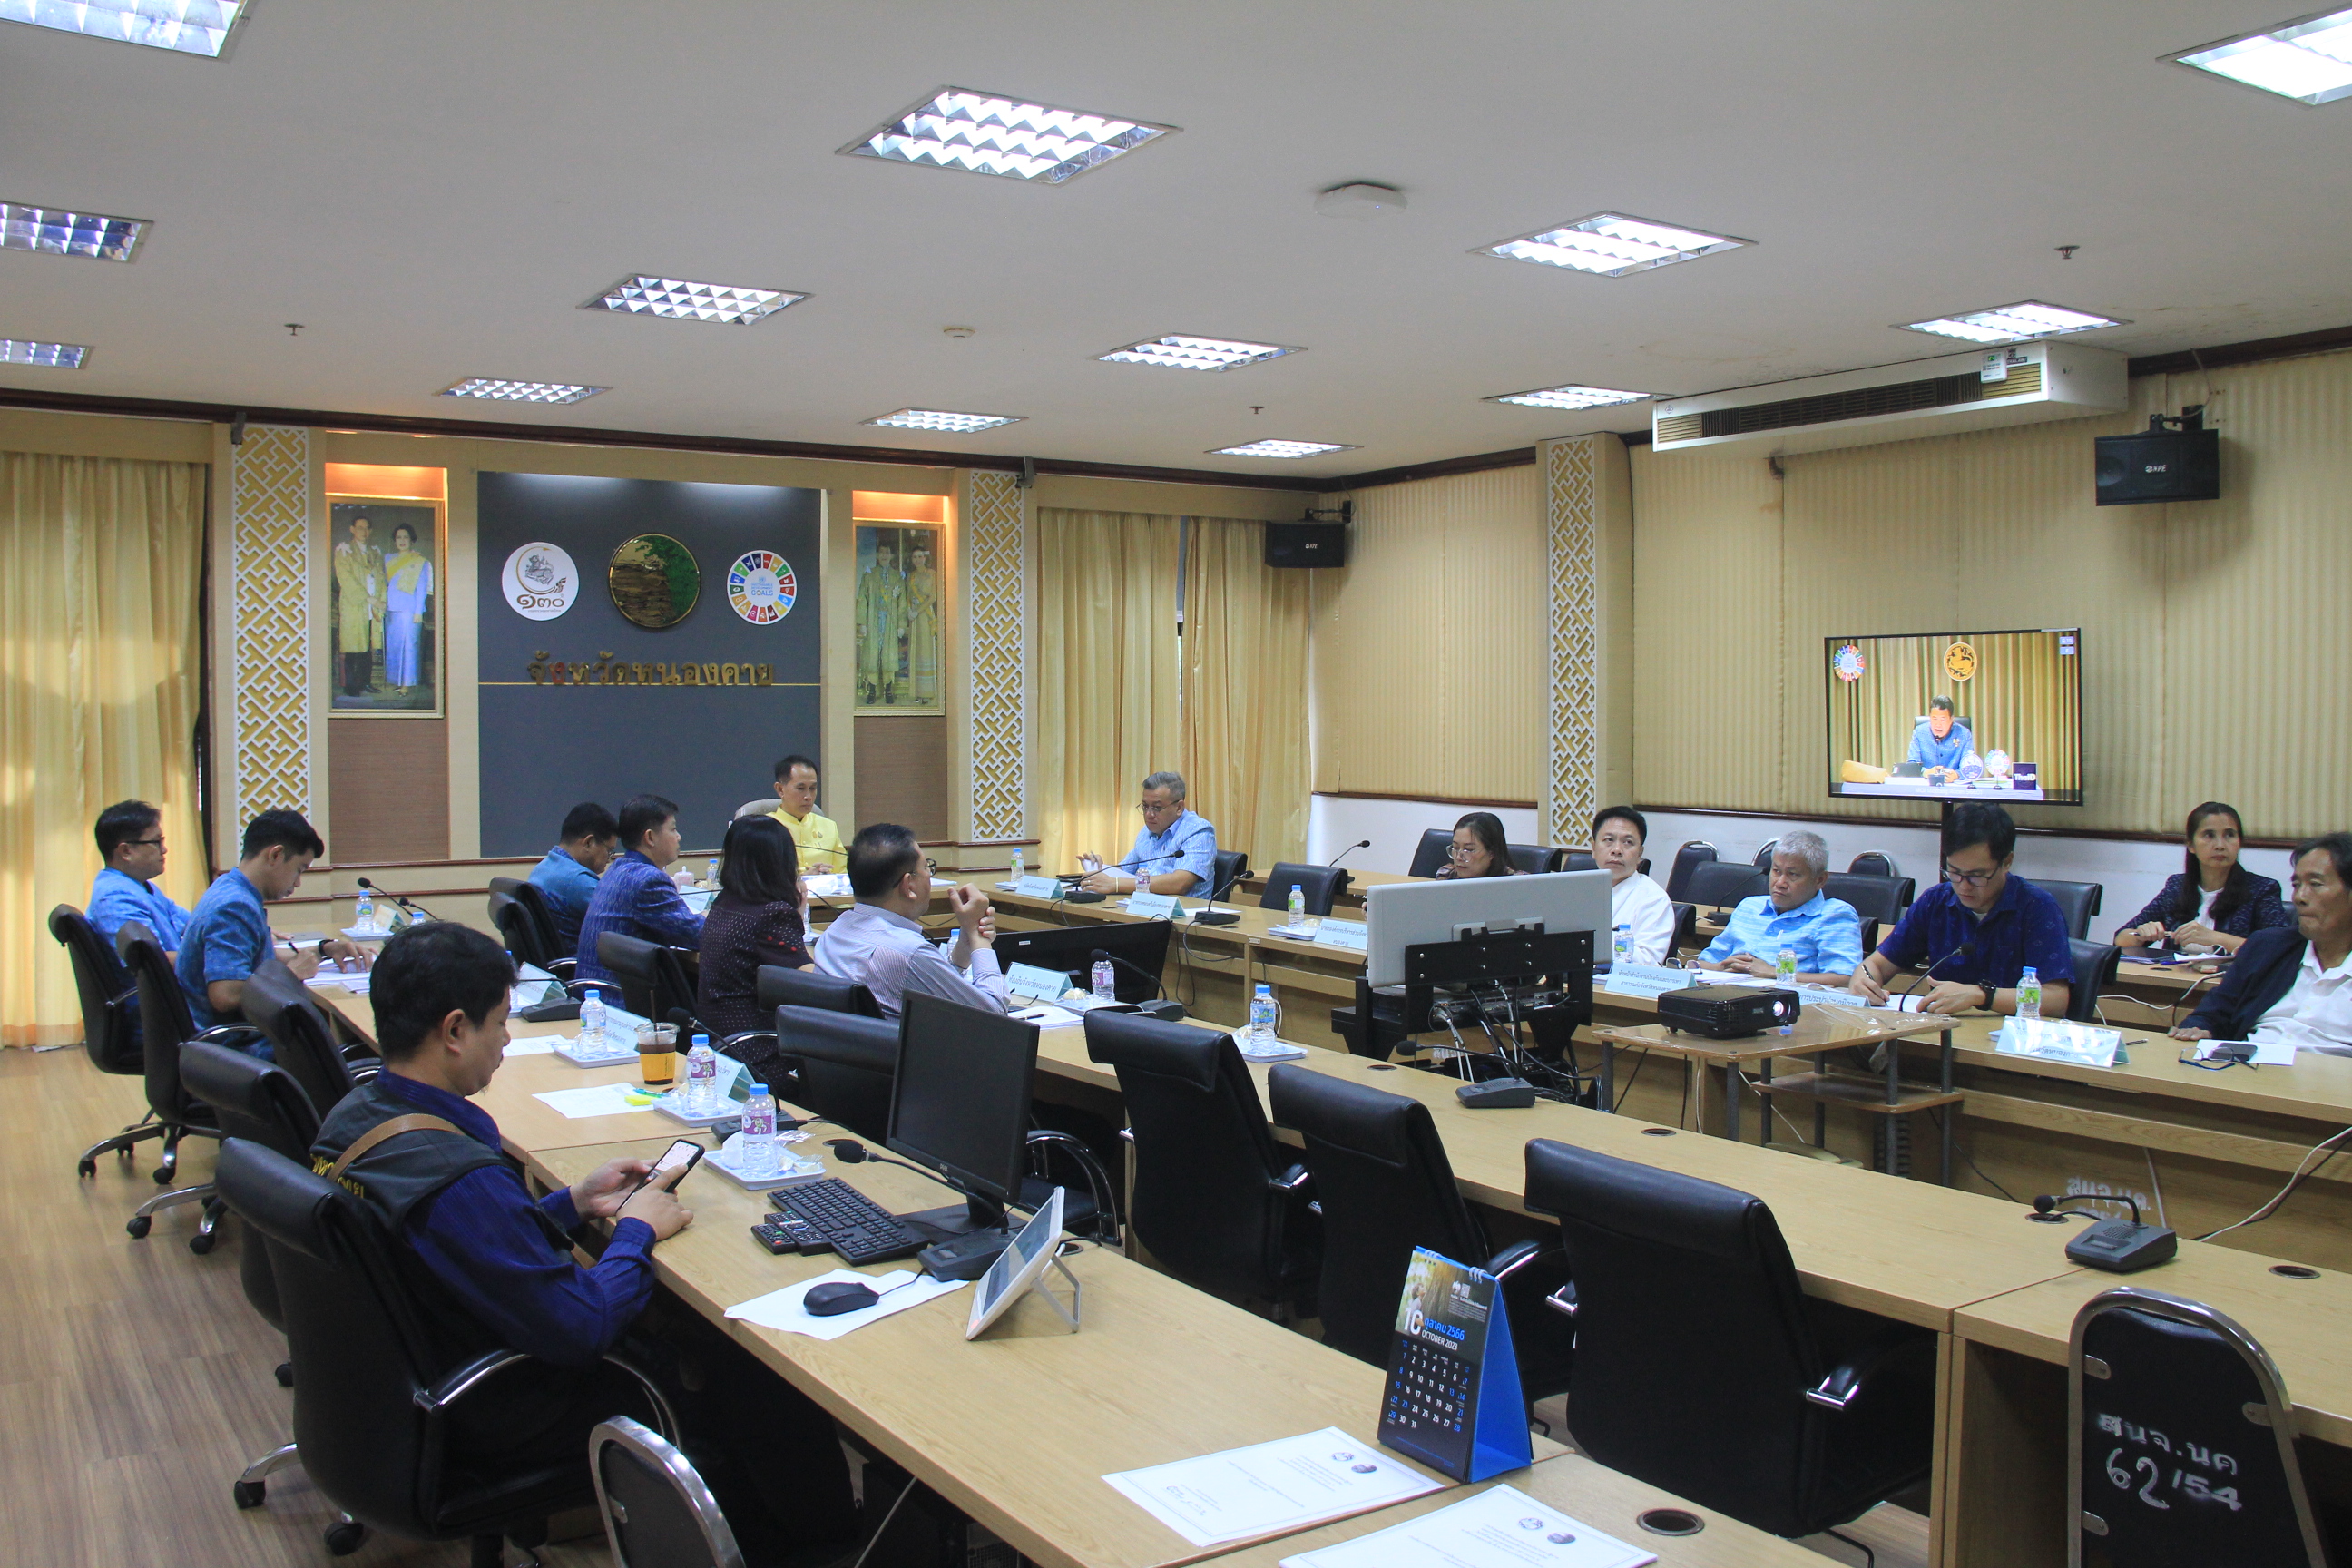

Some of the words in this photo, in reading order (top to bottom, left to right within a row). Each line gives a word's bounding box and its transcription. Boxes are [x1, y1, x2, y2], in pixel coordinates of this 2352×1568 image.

[2152, 464, 2167, 473] NPE
[527, 650, 774, 686] จังหวัดหนองคาย
[1421, 1329, 1446, 1346] OCTOBER
[1445, 1338, 1458, 1351] 2023
[1446, 1324, 1465, 1341] 2566
[1398, 1366, 1404, 1374] 8
[1409, 1370, 1414, 1379] 9
[1417, 1374, 1424, 1384] 10
[1428, 1379, 1434, 1388] 11
[1438, 1383, 1445, 1393] 12
[1449, 1387, 1455, 1396] 13
[1459, 1392, 1465, 1401] 14
[1411, 1356, 1416, 1365] 2
[1422, 1360, 1426, 1368] 3
[1442, 1368, 1446, 1377] 5
[1453, 1373, 1457, 1382] 6
[1396, 1380, 1401, 1389] 15
[1405, 1385, 1411, 1394] 16
[1416, 1389, 1421, 1397] 17
[1425, 1394, 1431, 1404] 18
[1436, 1398, 1442, 1407] 19
[1445, 1403, 1453, 1413] 20
[1457, 1408, 1464, 1416] 21
[1389, 1410, 1396, 1419] 29
[1398, 1415, 1406, 1424] 30
[1410, 1419, 1416, 1428] 31
[1392, 1395, 1398, 1404] 22
[1402, 1399, 1408, 1408] 23
[1411, 1405, 1418, 1414] 24
[1422, 1408, 1429, 1418] 25
[1432, 1413, 1439, 1423] 26
[1443, 1418, 1450, 1427] 27
[1453, 1423, 1461, 1432] 28
[2105, 1447, 2170, 1510] 62
[2171, 1468, 2243, 1511] 154
